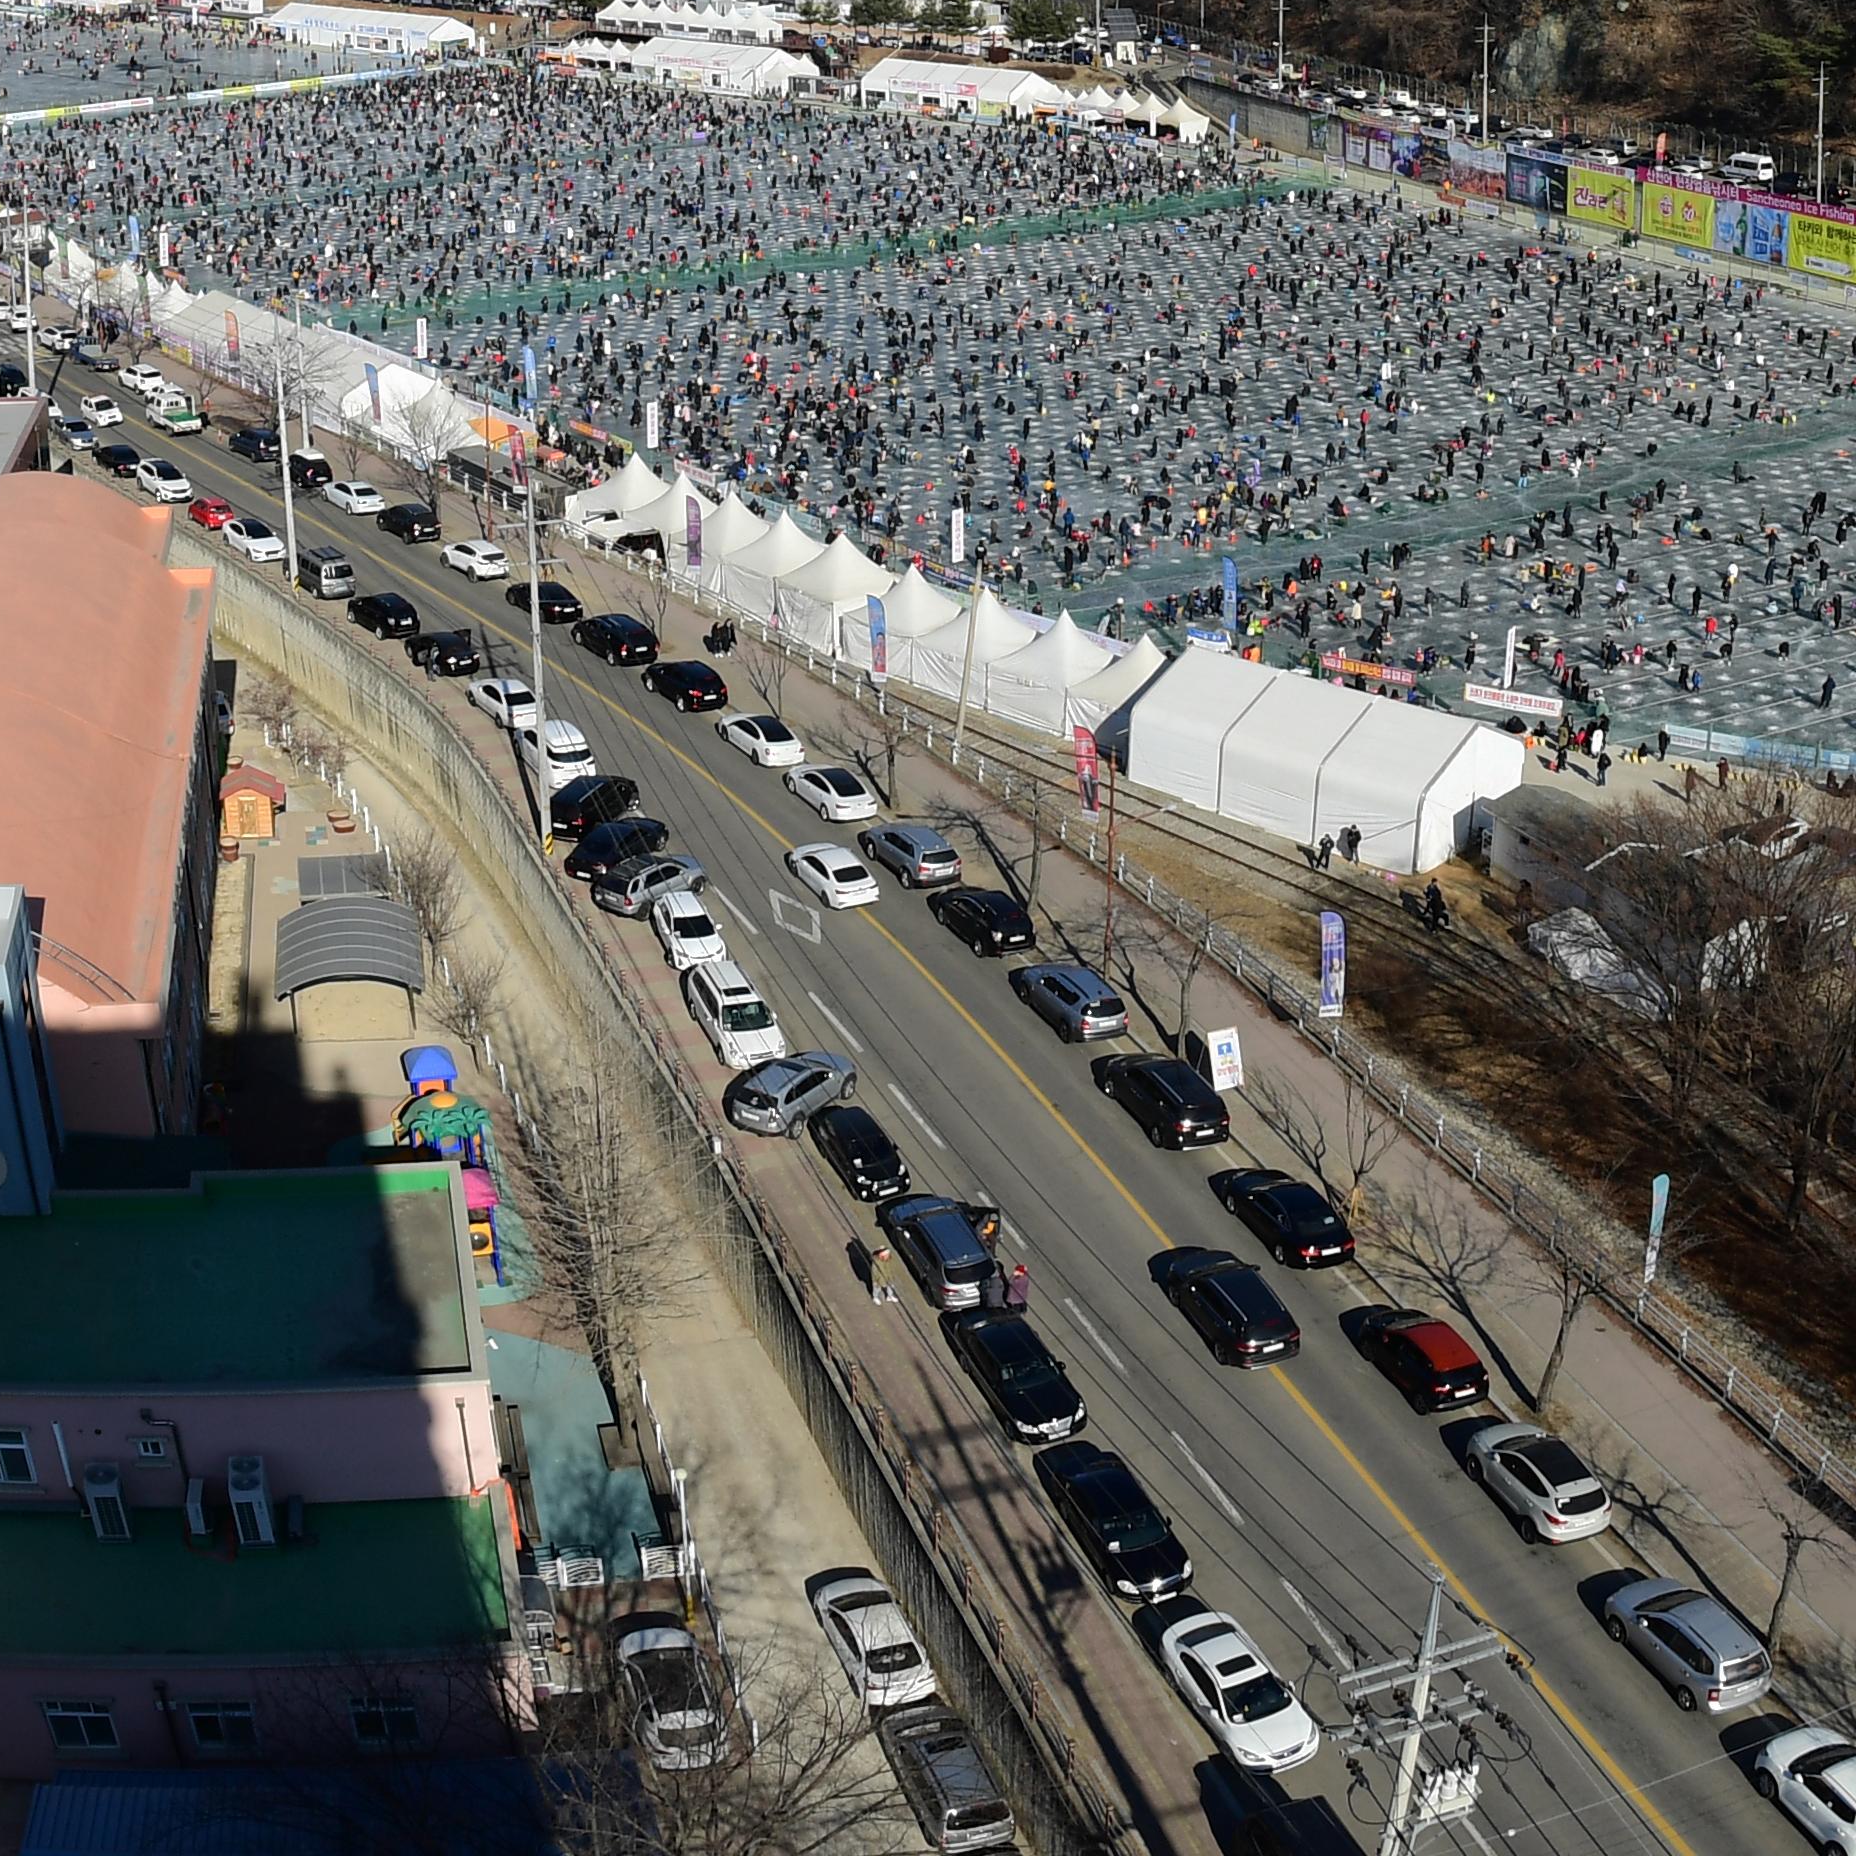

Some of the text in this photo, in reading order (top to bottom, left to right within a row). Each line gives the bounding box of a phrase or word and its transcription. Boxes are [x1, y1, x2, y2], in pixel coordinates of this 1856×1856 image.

[1646, 168, 1673, 187] 산천어
[1746, 190, 1856, 224] Sancheoneo Ice Fishing
